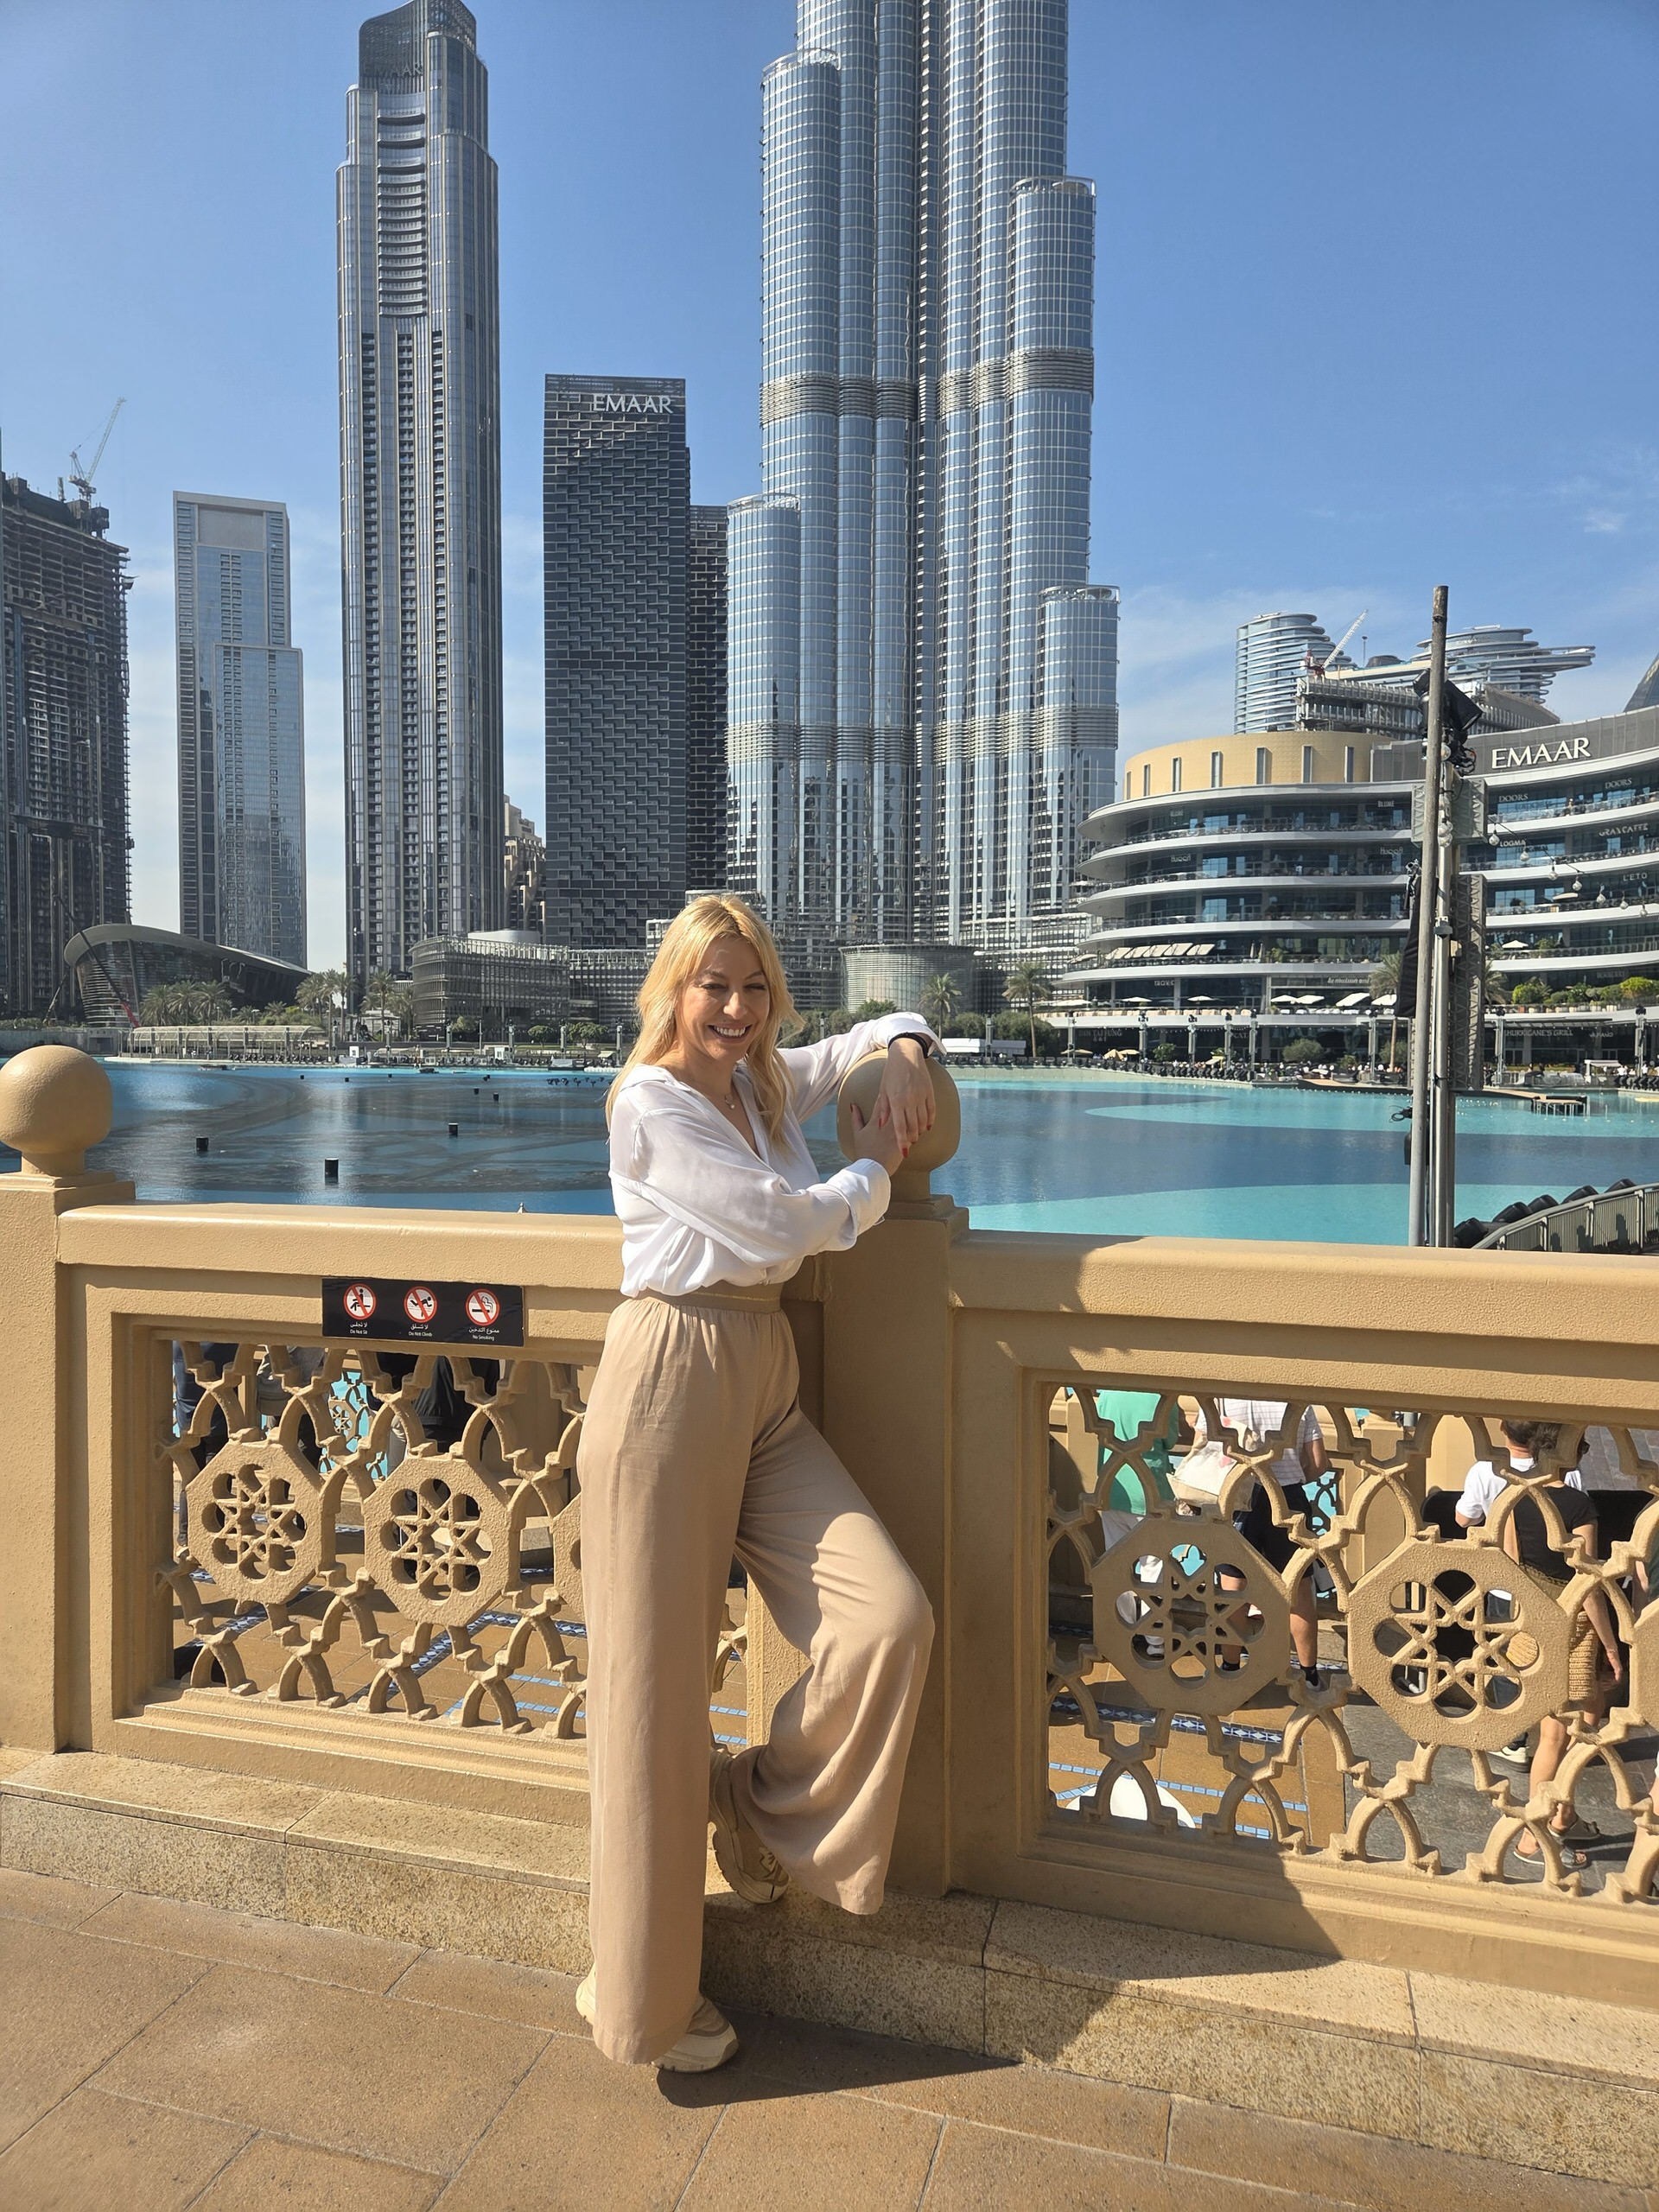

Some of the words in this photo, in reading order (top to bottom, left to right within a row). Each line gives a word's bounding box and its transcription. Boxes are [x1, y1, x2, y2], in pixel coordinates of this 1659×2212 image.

[593, 394, 674, 414] EMAAR
[1491, 737, 1591, 769] EMAAR
[1605, 778, 1632, 789] DOORS
[1498, 794, 1529, 803] DOORS
[1623, 872, 1648, 882] L'ETO
